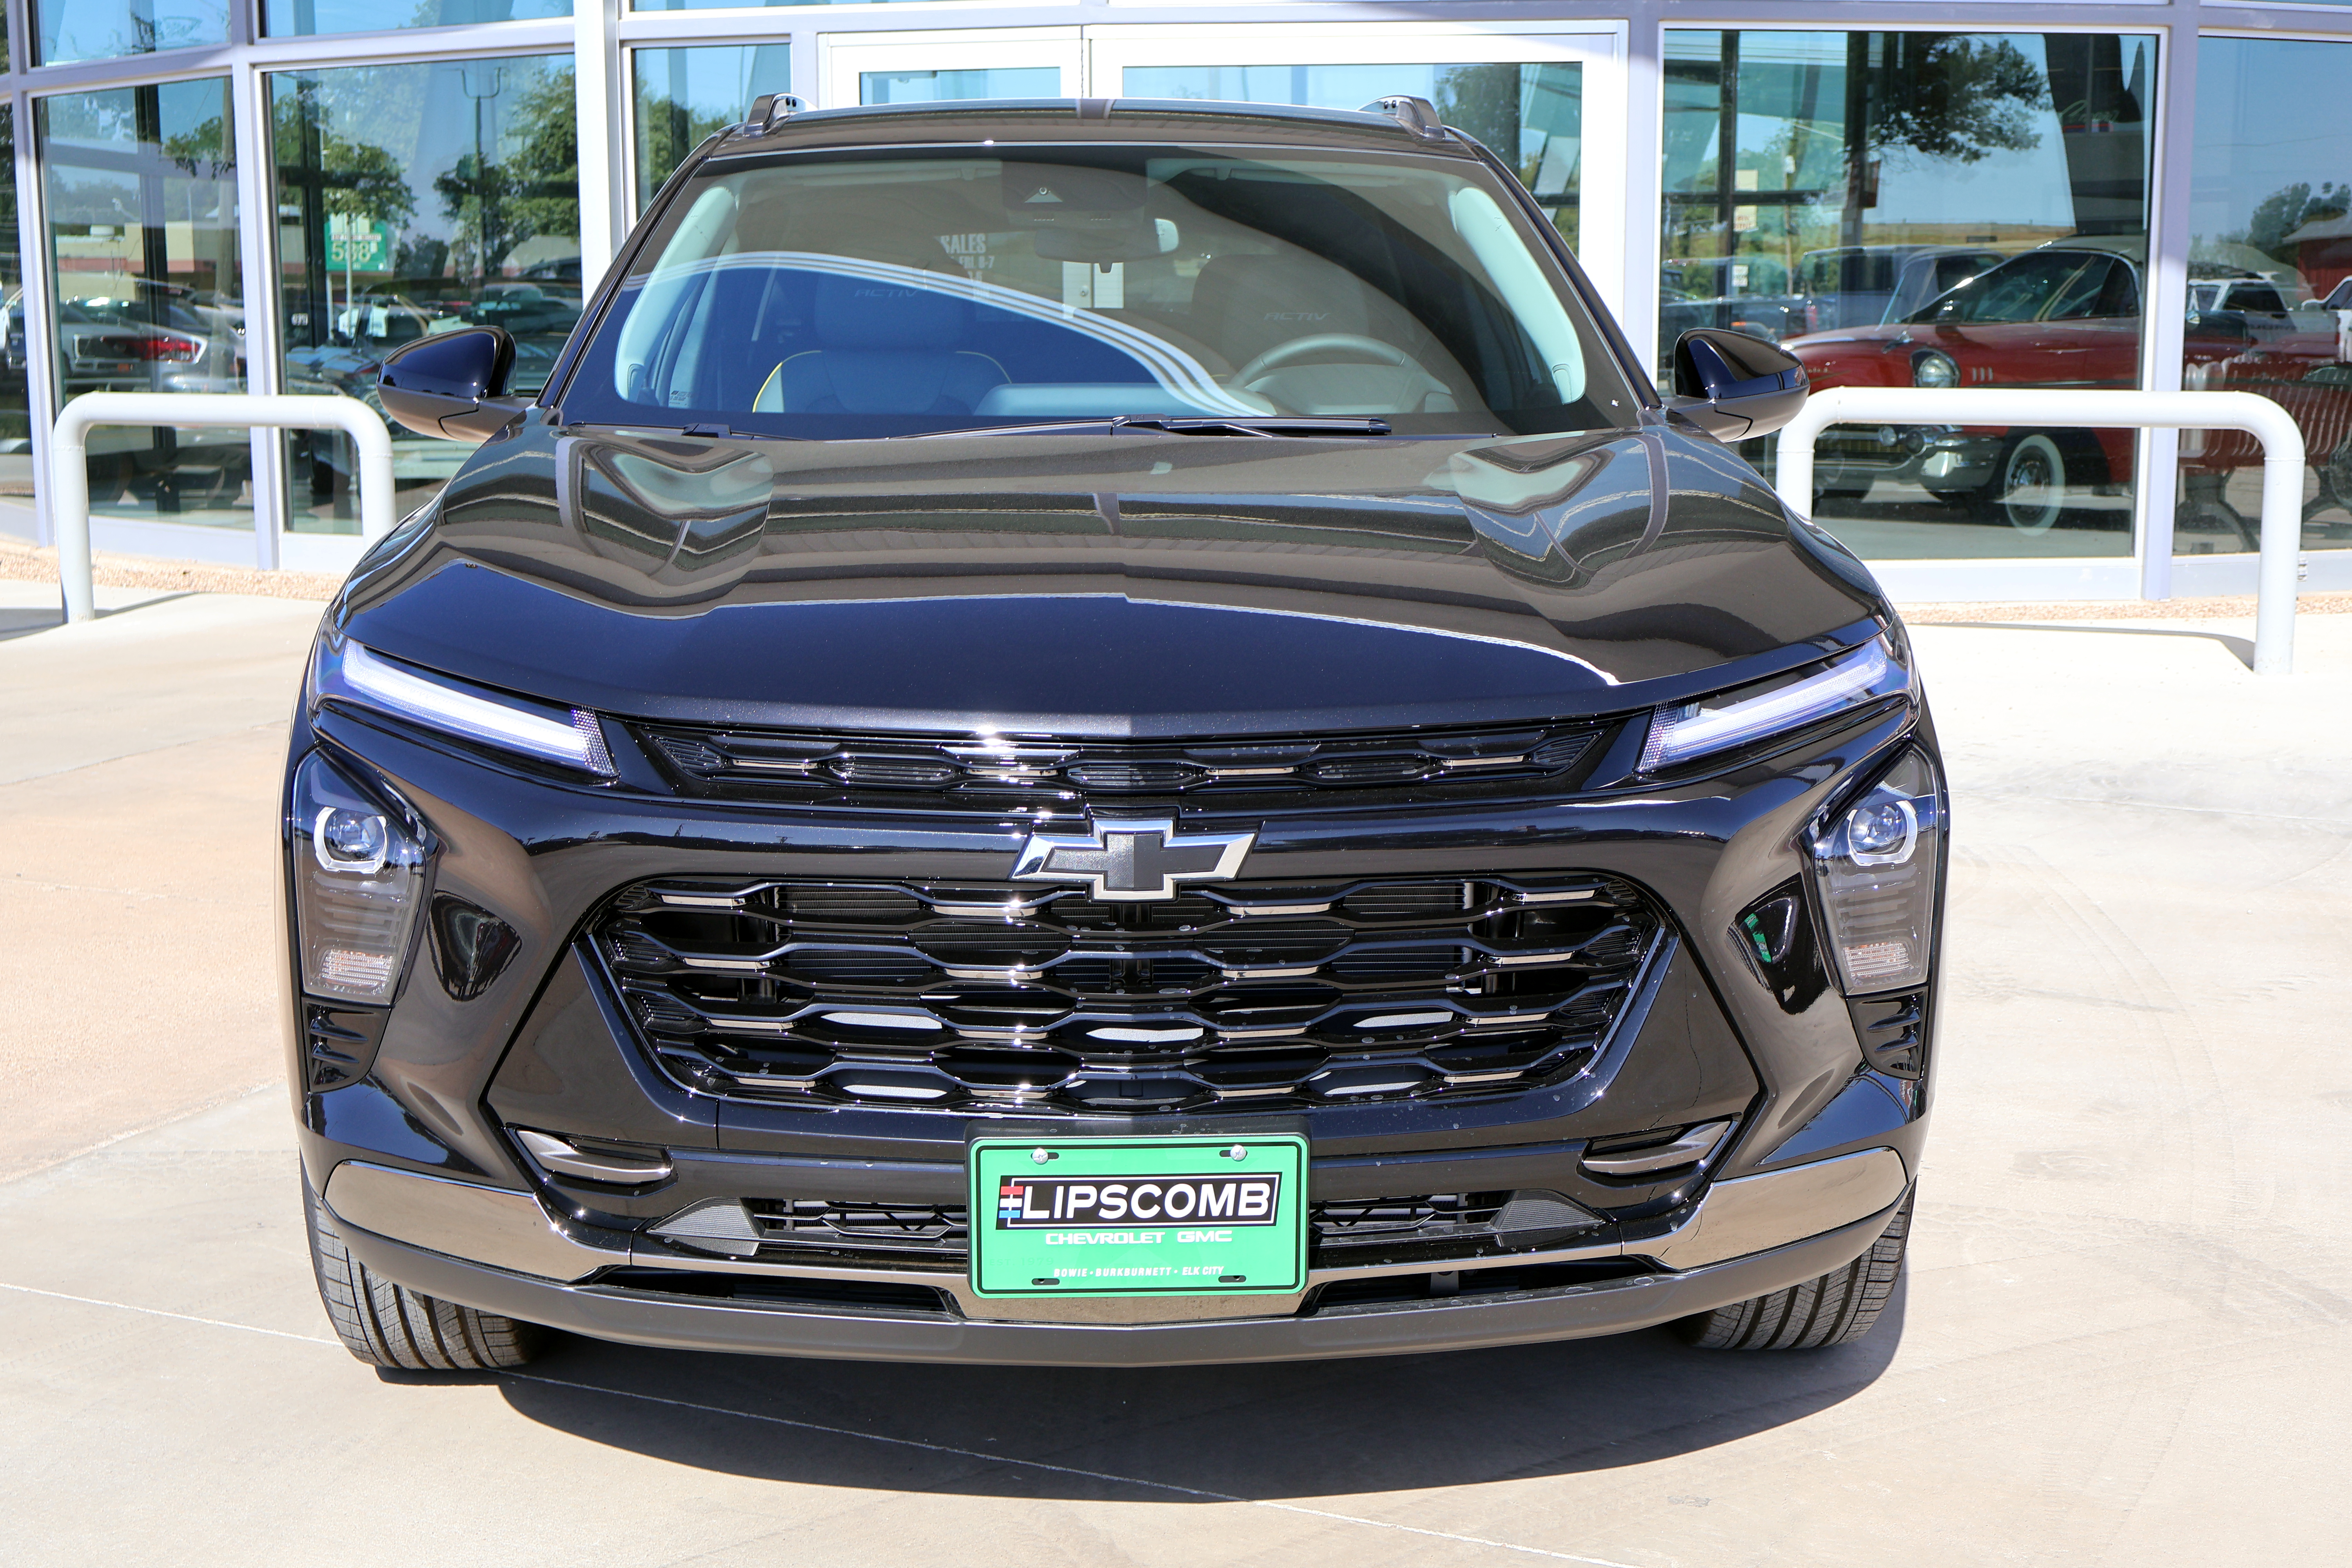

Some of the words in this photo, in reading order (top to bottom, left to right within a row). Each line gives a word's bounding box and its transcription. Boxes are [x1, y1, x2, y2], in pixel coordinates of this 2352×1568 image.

[940, 232, 987, 254] SALES
[1022, 1183, 1270, 1219] LIPSCOMB
[1045, 1232, 1165, 1245] CHEVROLET
[1177, 1230, 1232, 1243] GMC
[1021, 1257, 1054, 1266] 1979
[1053, 1268, 1088, 1277] BOWIE
[1095, 1267, 1172, 1277] BURKBURNETT
[1182, 1267, 1200, 1276] ELK
[1202, 1266, 1224, 1275] CITY
